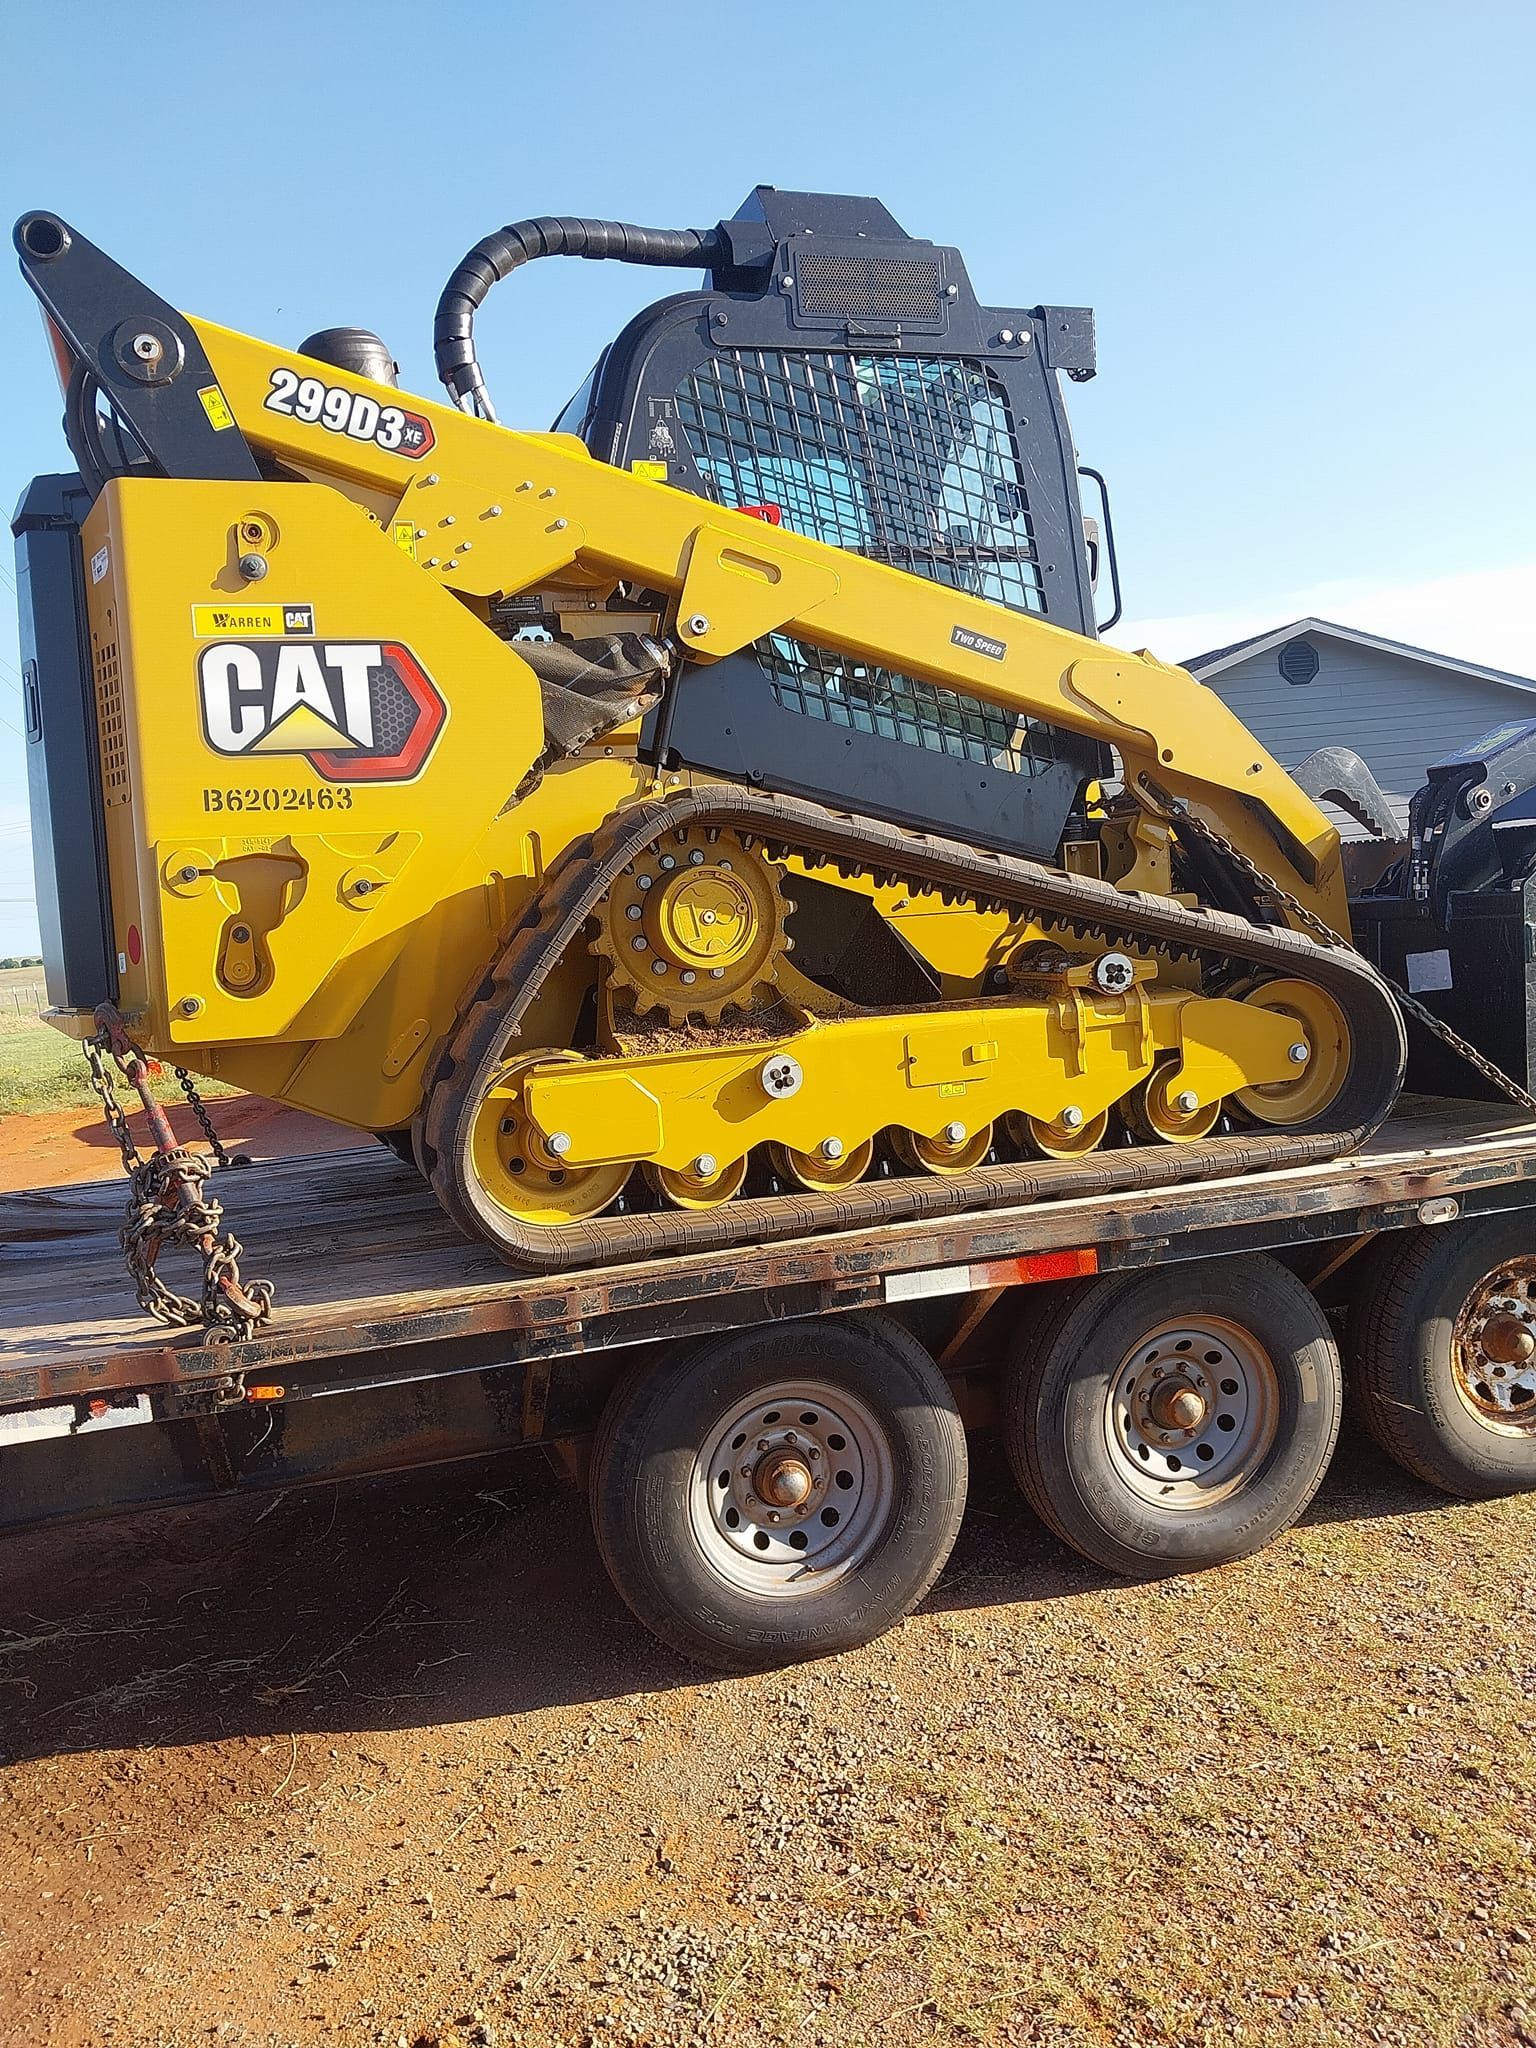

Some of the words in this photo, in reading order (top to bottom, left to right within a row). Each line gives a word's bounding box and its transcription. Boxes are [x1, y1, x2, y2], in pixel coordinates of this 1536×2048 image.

[265, 368, 406, 450] 299D3
[404, 427, 423, 445] XE
[212, 612, 272, 628] WARREN
[285, 612, 311, 628] CAT
[201, 643, 383, 752] CAT
[202, 787, 354, 812] B6202463
